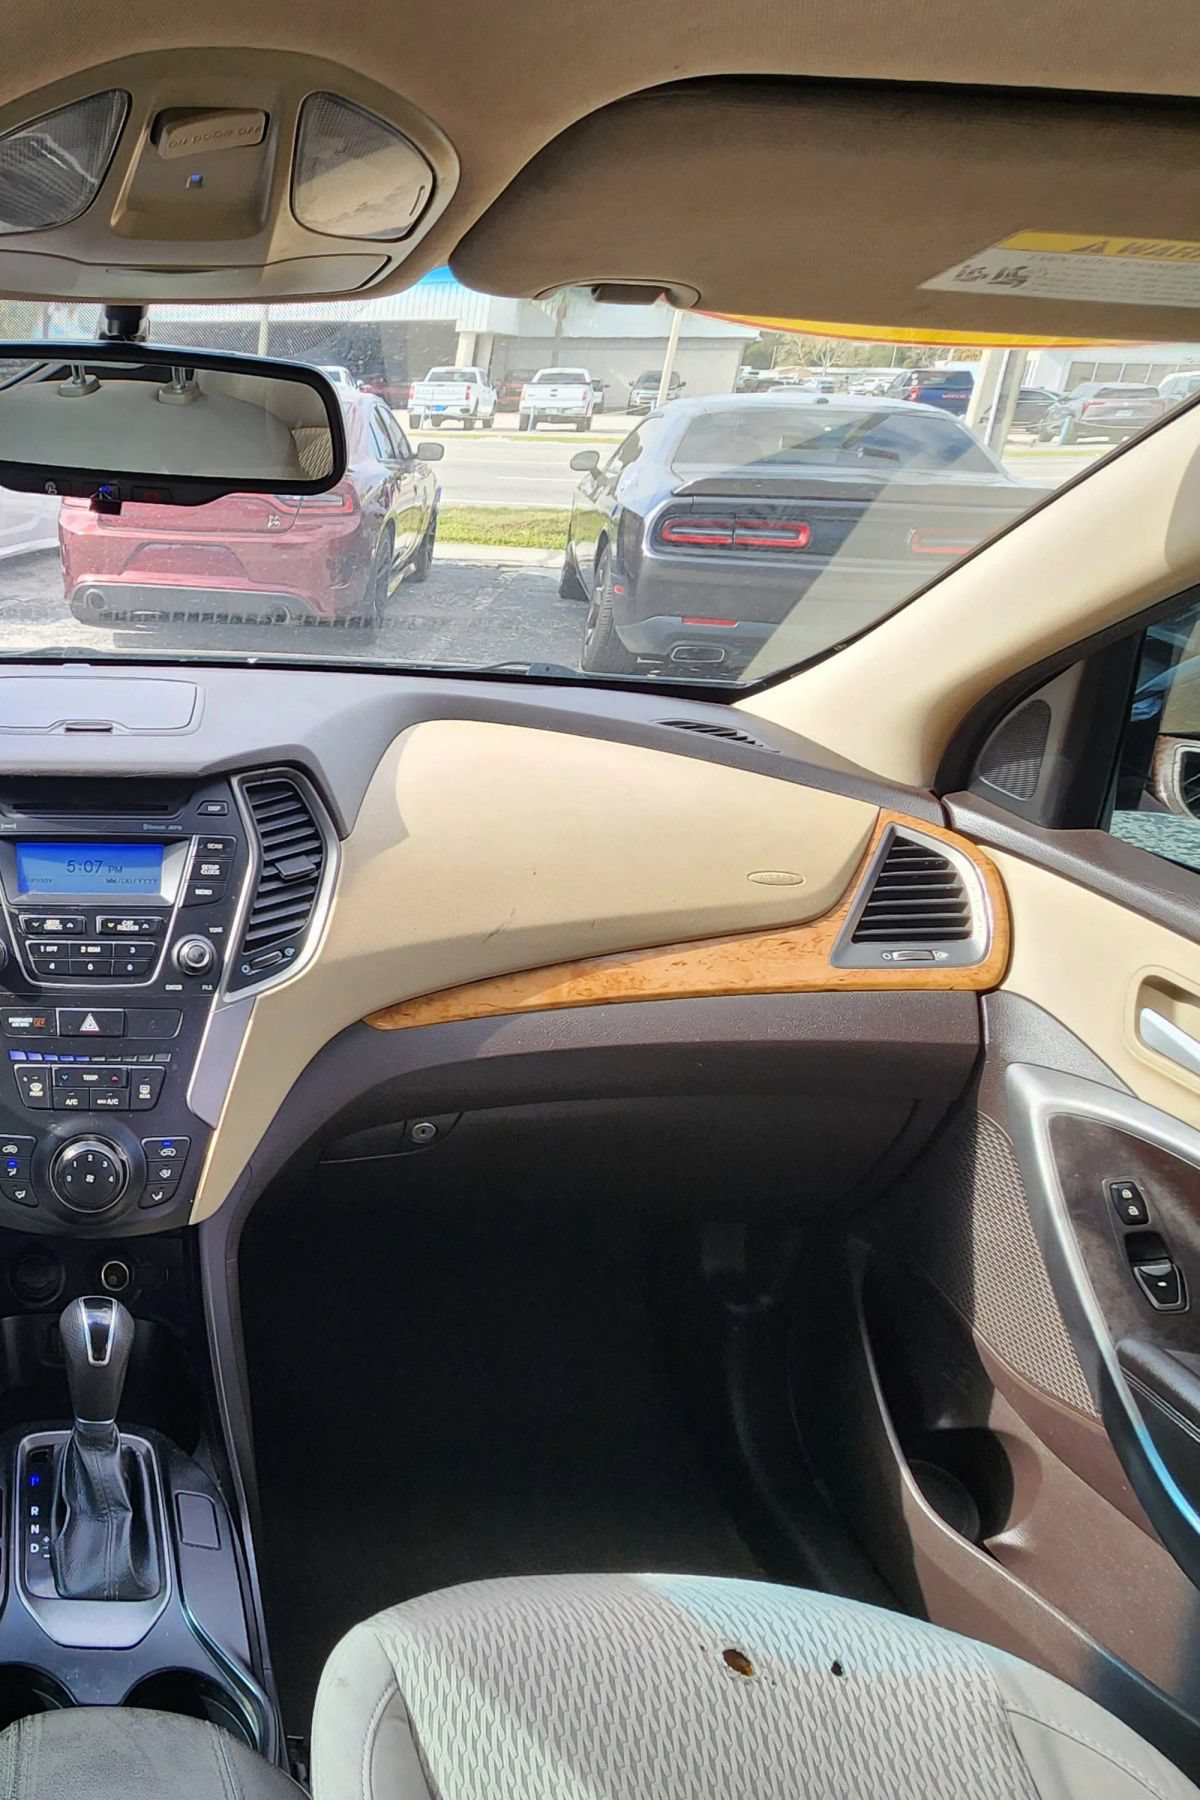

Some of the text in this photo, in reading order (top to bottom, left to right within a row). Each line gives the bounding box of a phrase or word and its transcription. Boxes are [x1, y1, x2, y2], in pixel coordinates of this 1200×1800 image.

[66, 859, 122, 874] 5:07 PM
[65, 1098, 79, 1106] A/C
[87, 1154, 93, 1162] 2
[73, 1160, 77, 1168] 1
[102, 1160, 108, 1168] 3
[31, 1506, 39, 1516] R
[30, 1524, 40, 1534] N
[30, 1543, 40, 1553] D
